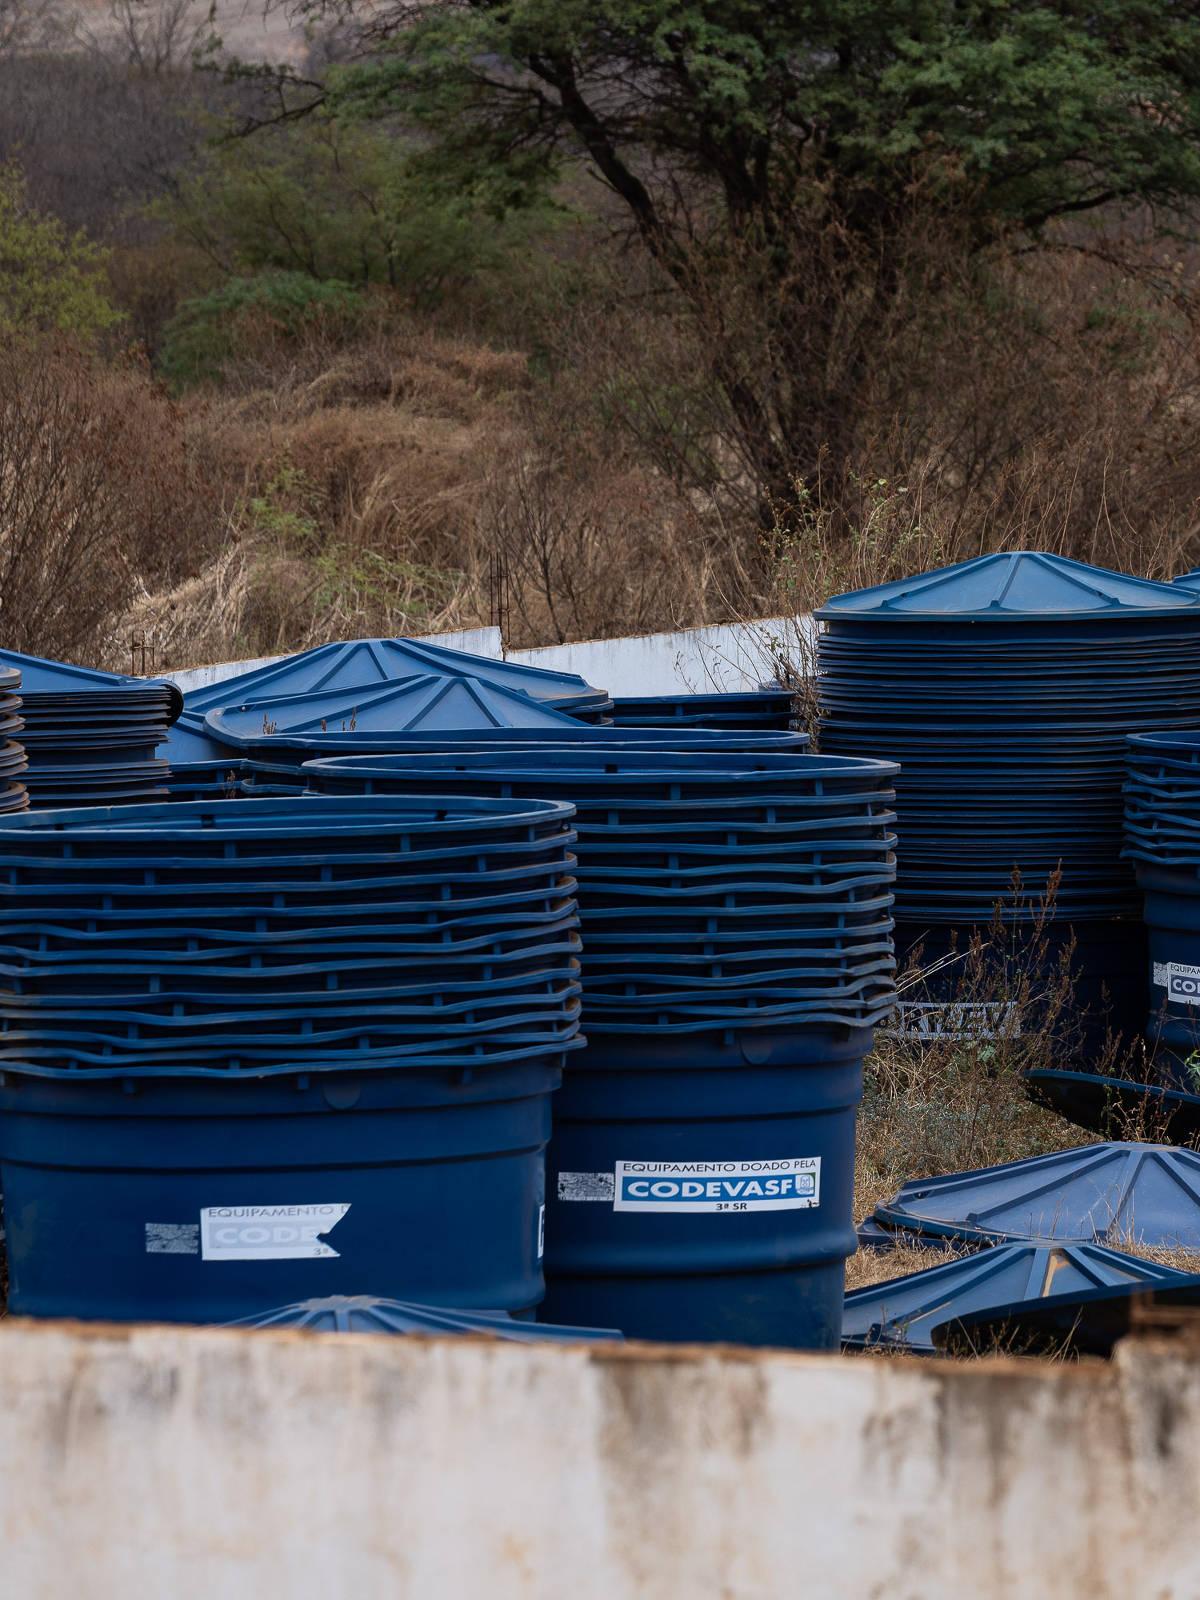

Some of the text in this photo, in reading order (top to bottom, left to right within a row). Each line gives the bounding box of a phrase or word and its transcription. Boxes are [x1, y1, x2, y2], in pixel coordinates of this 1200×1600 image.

[622, 1159, 817, 1173] EQUIPAMENTO DOADO PELA
[627, 1179, 793, 1198] CODEVASF
[208, 1205, 335, 1218] EQUIPAMENTO
[732, 1202, 748, 1210] SR
